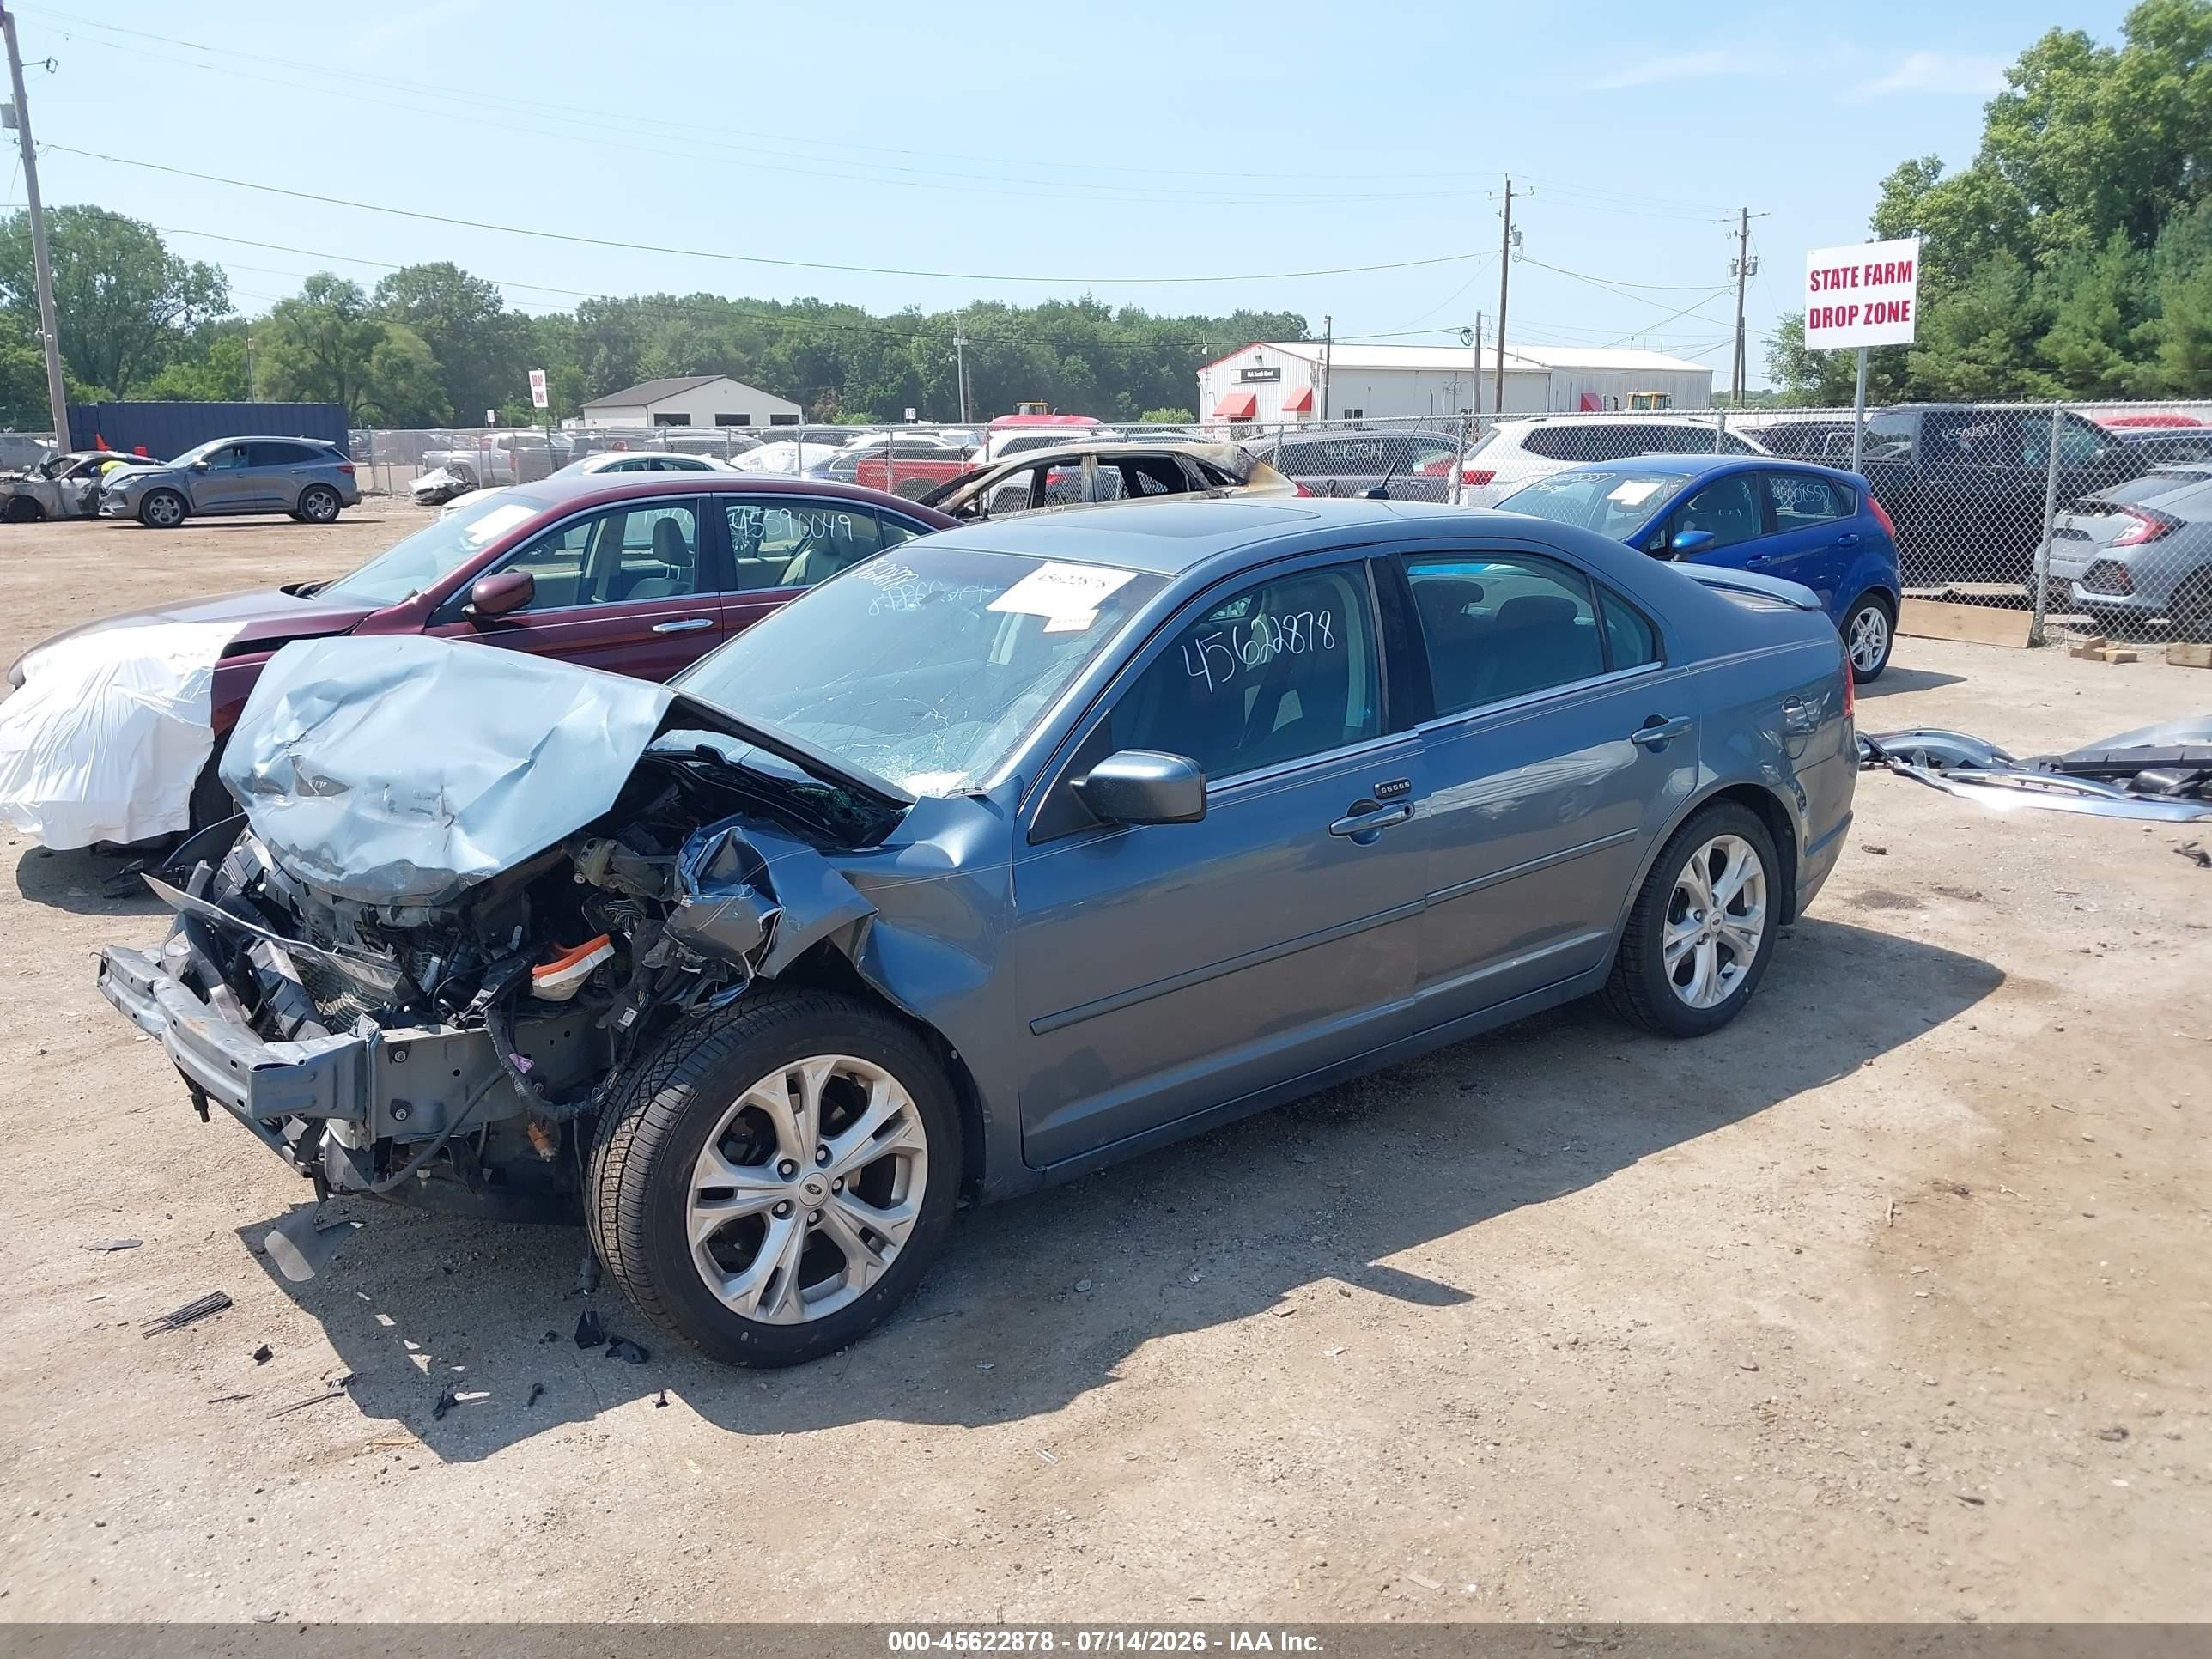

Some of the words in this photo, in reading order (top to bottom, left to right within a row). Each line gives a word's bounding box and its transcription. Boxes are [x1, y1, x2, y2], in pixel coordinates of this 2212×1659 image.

[1809, 266, 1860, 292] STATE
[1863, 260, 1913, 287] FARM
[1809, 304, 1859, 330] DROP
[1863, 300, 1911, 325] ZONE
[1181, 610, 1336, 695] 45622878
